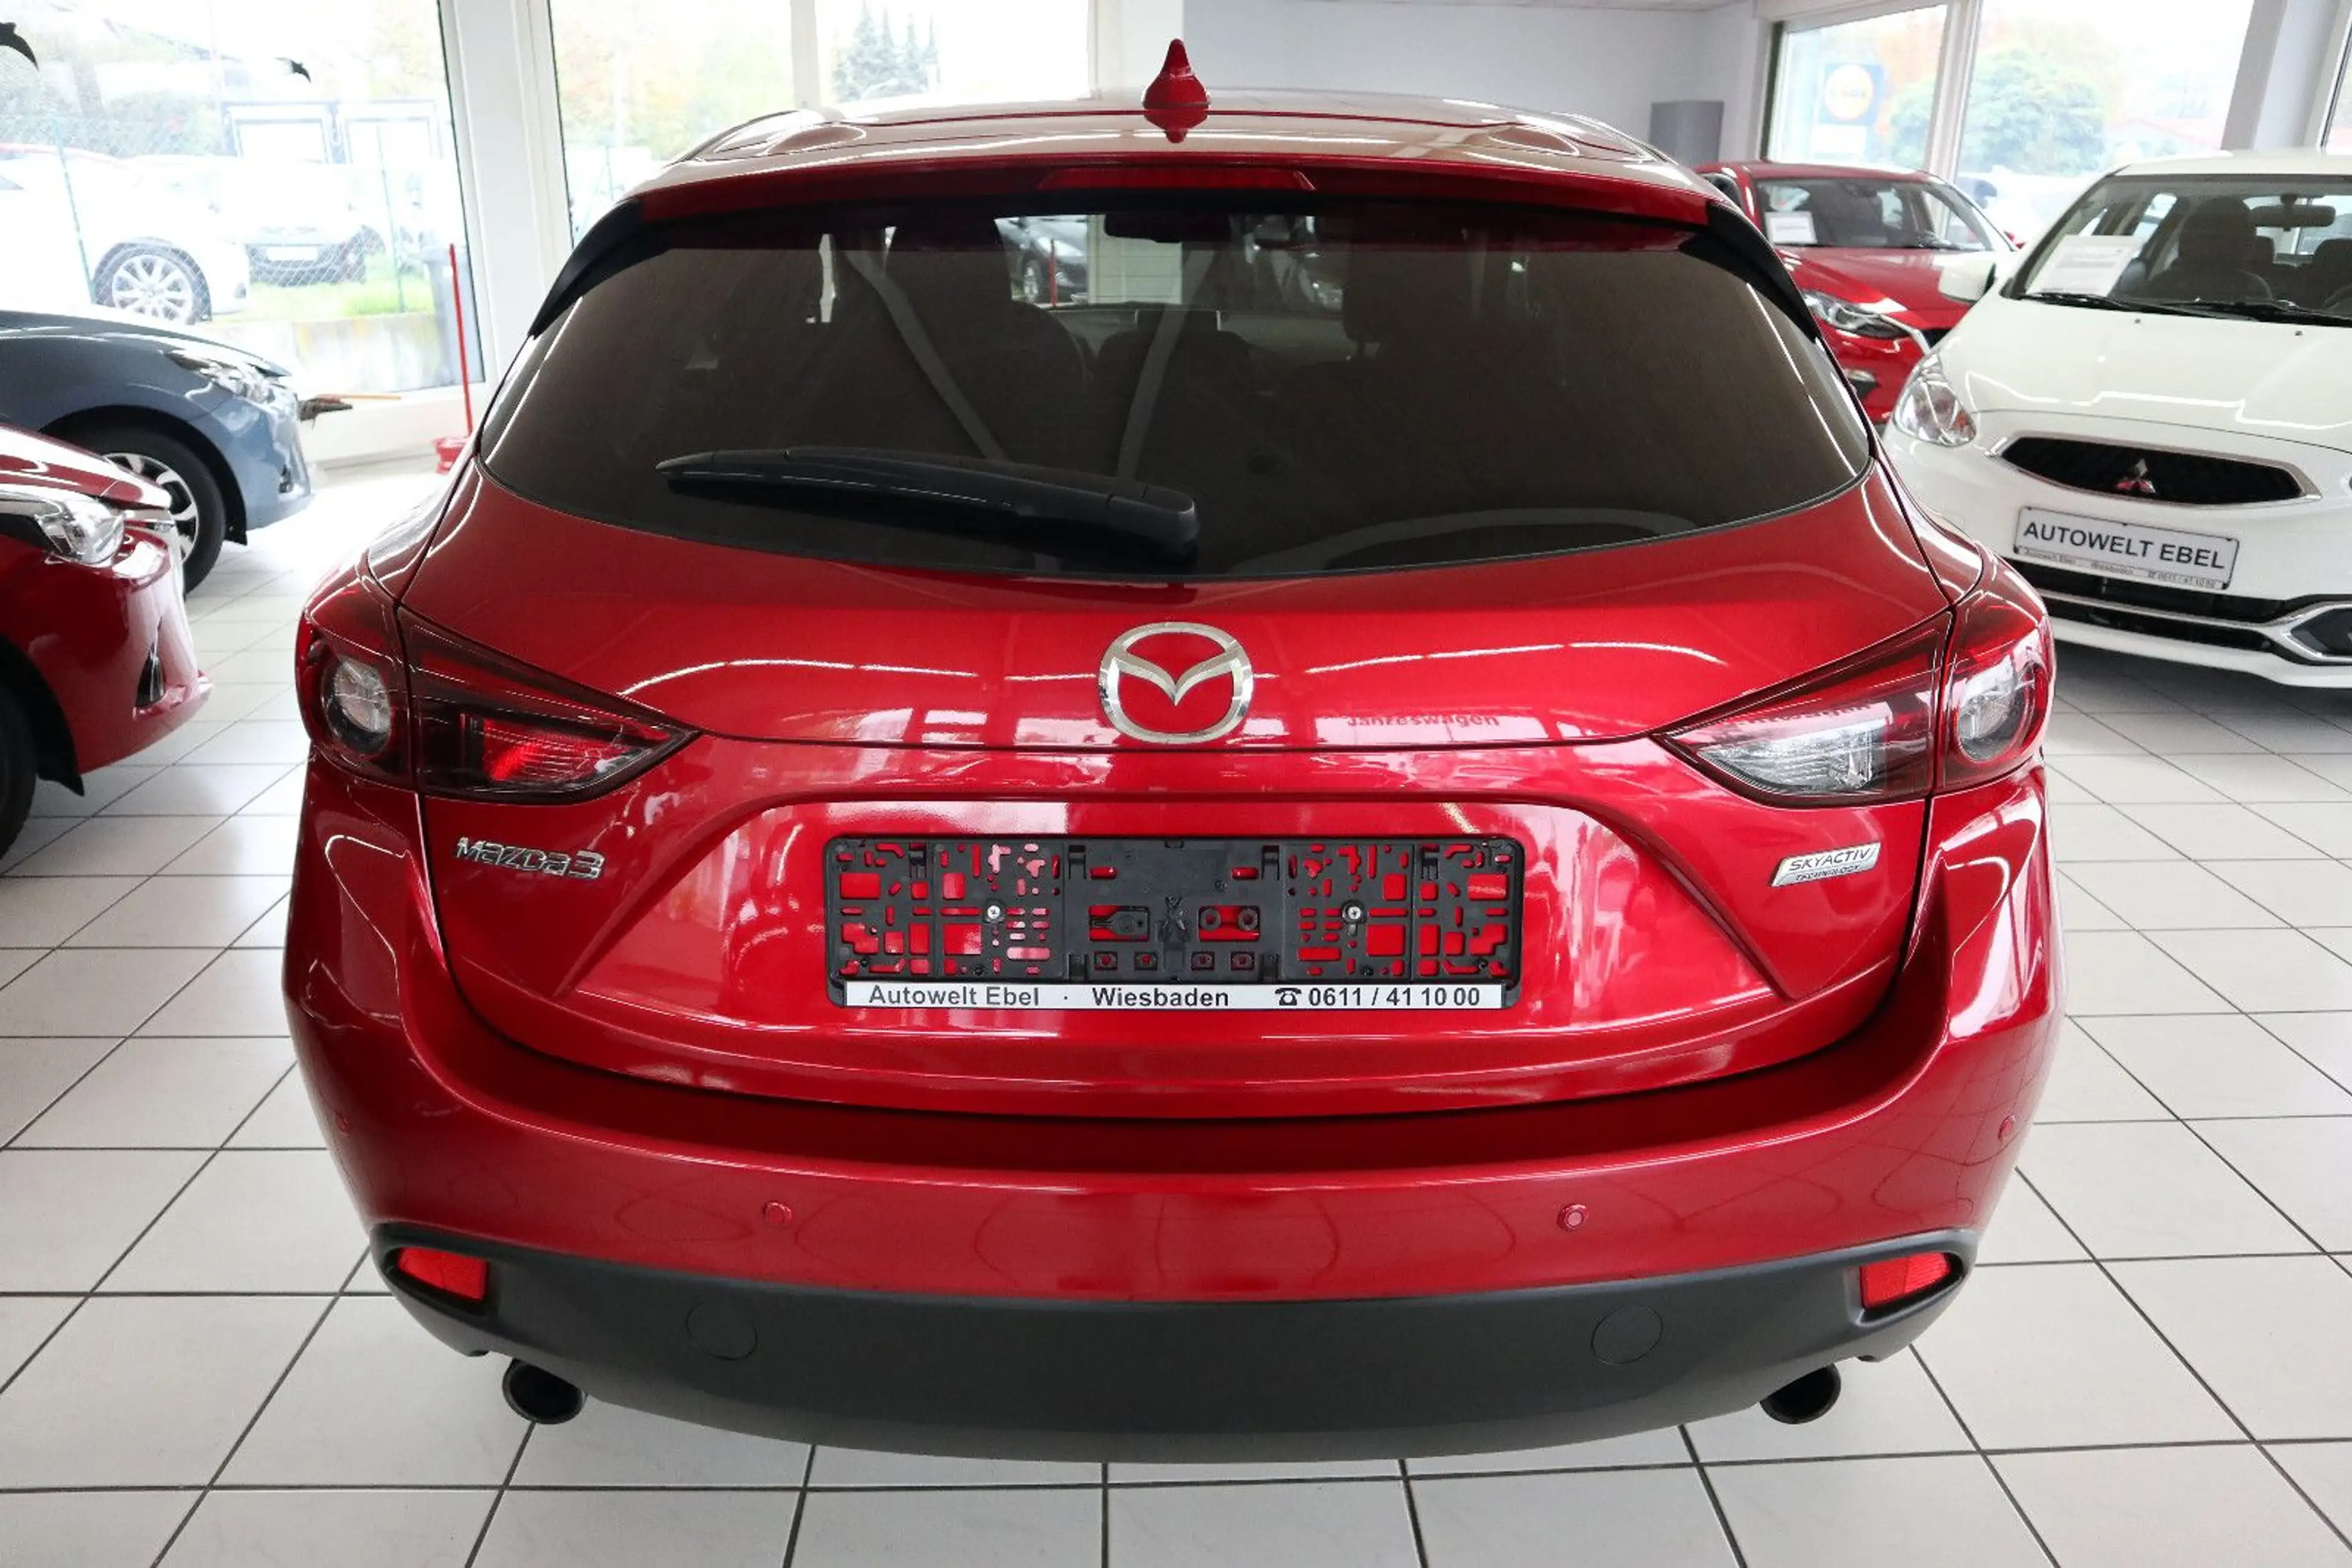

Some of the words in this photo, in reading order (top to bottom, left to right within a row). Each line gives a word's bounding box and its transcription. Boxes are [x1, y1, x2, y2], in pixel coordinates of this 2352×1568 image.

[2023, 521, 2154, 558] AUTOWELT
[2159, 543, 2225, 569] EBEL
[1789, 847, 1871, 871] SKYACTIV
[869, 984, 977, 1005] Autowelt
[986, 986, 1039, 1006] Ebel
[1091, 987, 1229, 1006] Wiesbaden
[1308, 987, 1362, 1006] 0611
[1371, 987, 1379, 1006] /
[1385, 987, 1411, 1006] 41
[1422, 987, 1447, 1006] 10
[1453, 987, 1480, 1006] 00
